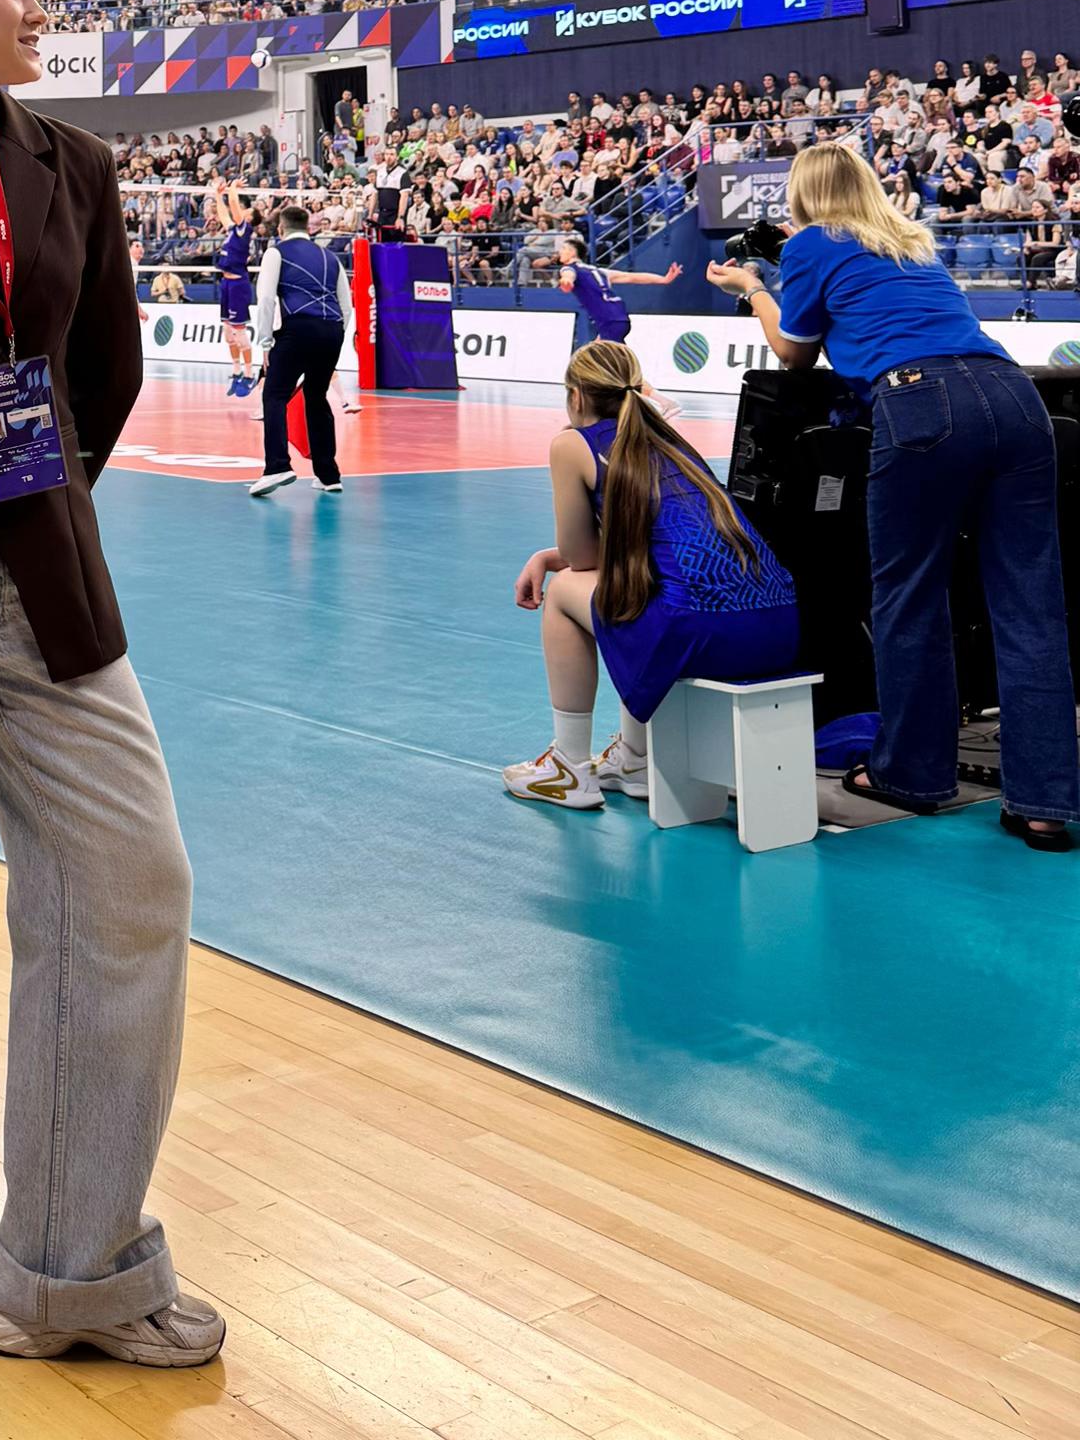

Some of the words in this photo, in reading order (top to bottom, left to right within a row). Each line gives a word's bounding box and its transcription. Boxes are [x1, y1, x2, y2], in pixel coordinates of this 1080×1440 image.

[575, 5, 647, 30] КУБОК
[453, 20, 529, 45] РОССИИ
[416, 285, 449, 298] РОЛЬФ
